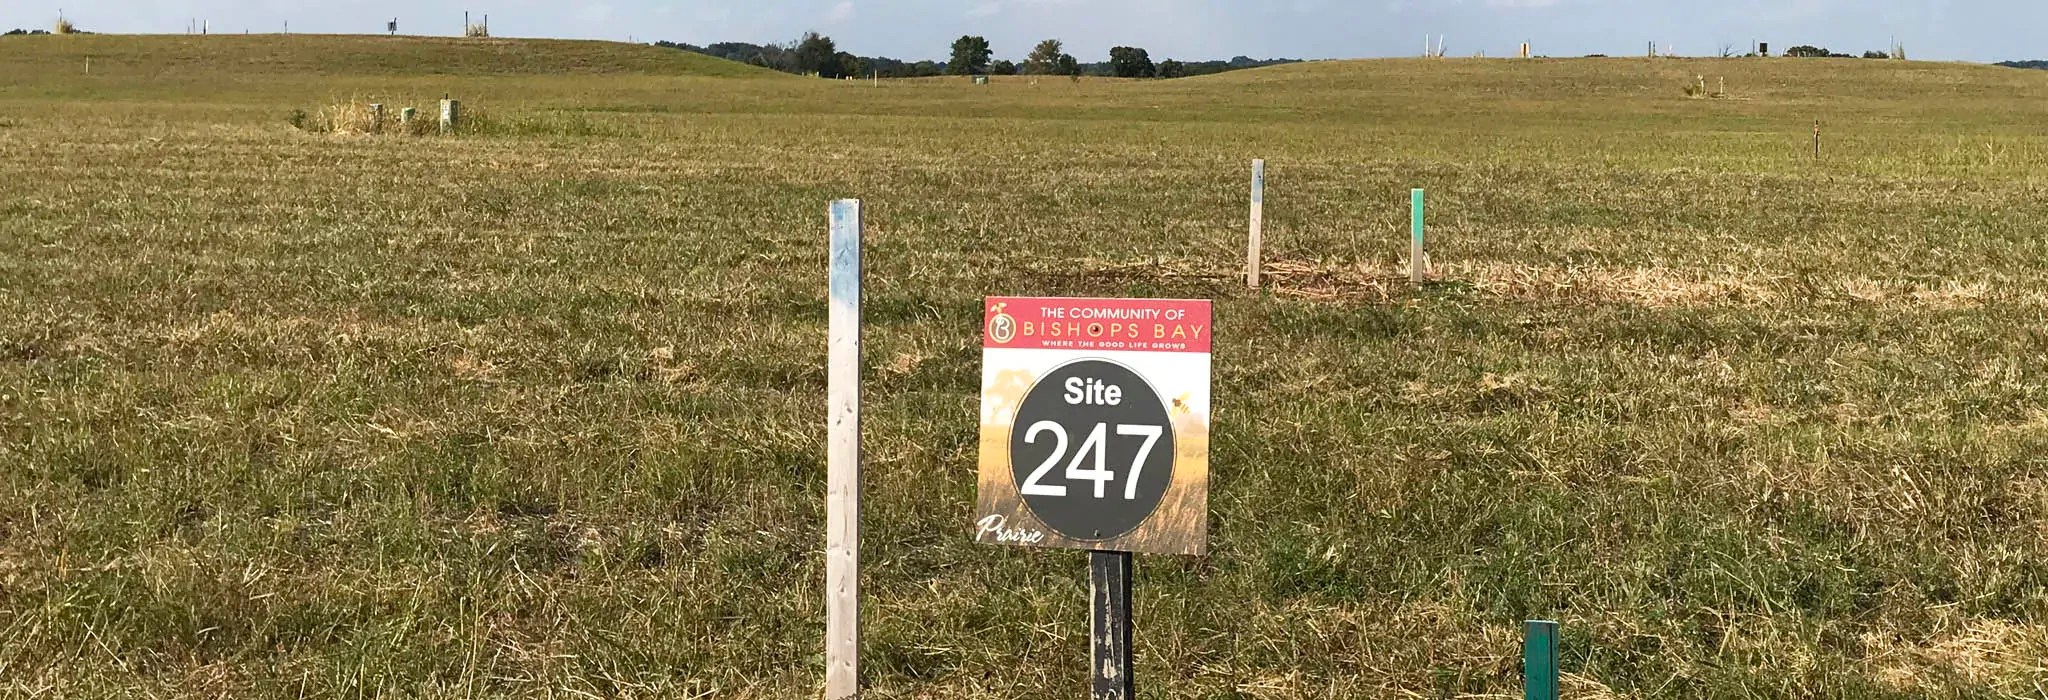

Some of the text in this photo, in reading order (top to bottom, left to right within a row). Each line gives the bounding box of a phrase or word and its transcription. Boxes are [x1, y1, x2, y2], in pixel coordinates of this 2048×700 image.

[1041, 307, 1186, 321] THE COMMUNITY OF
[1023, 322, 1204, 340] BISHOPS BAY
[1078, 340, 1095, 348] THE
[1129, 341, 1148, 349] LIFE
[1152, 342, 1186, 350] GROWS
[1063, 376, 1123, 406] Site
[1020, 420, 1163, 500] 247
[976, 514, 1044, 544] Prairie
